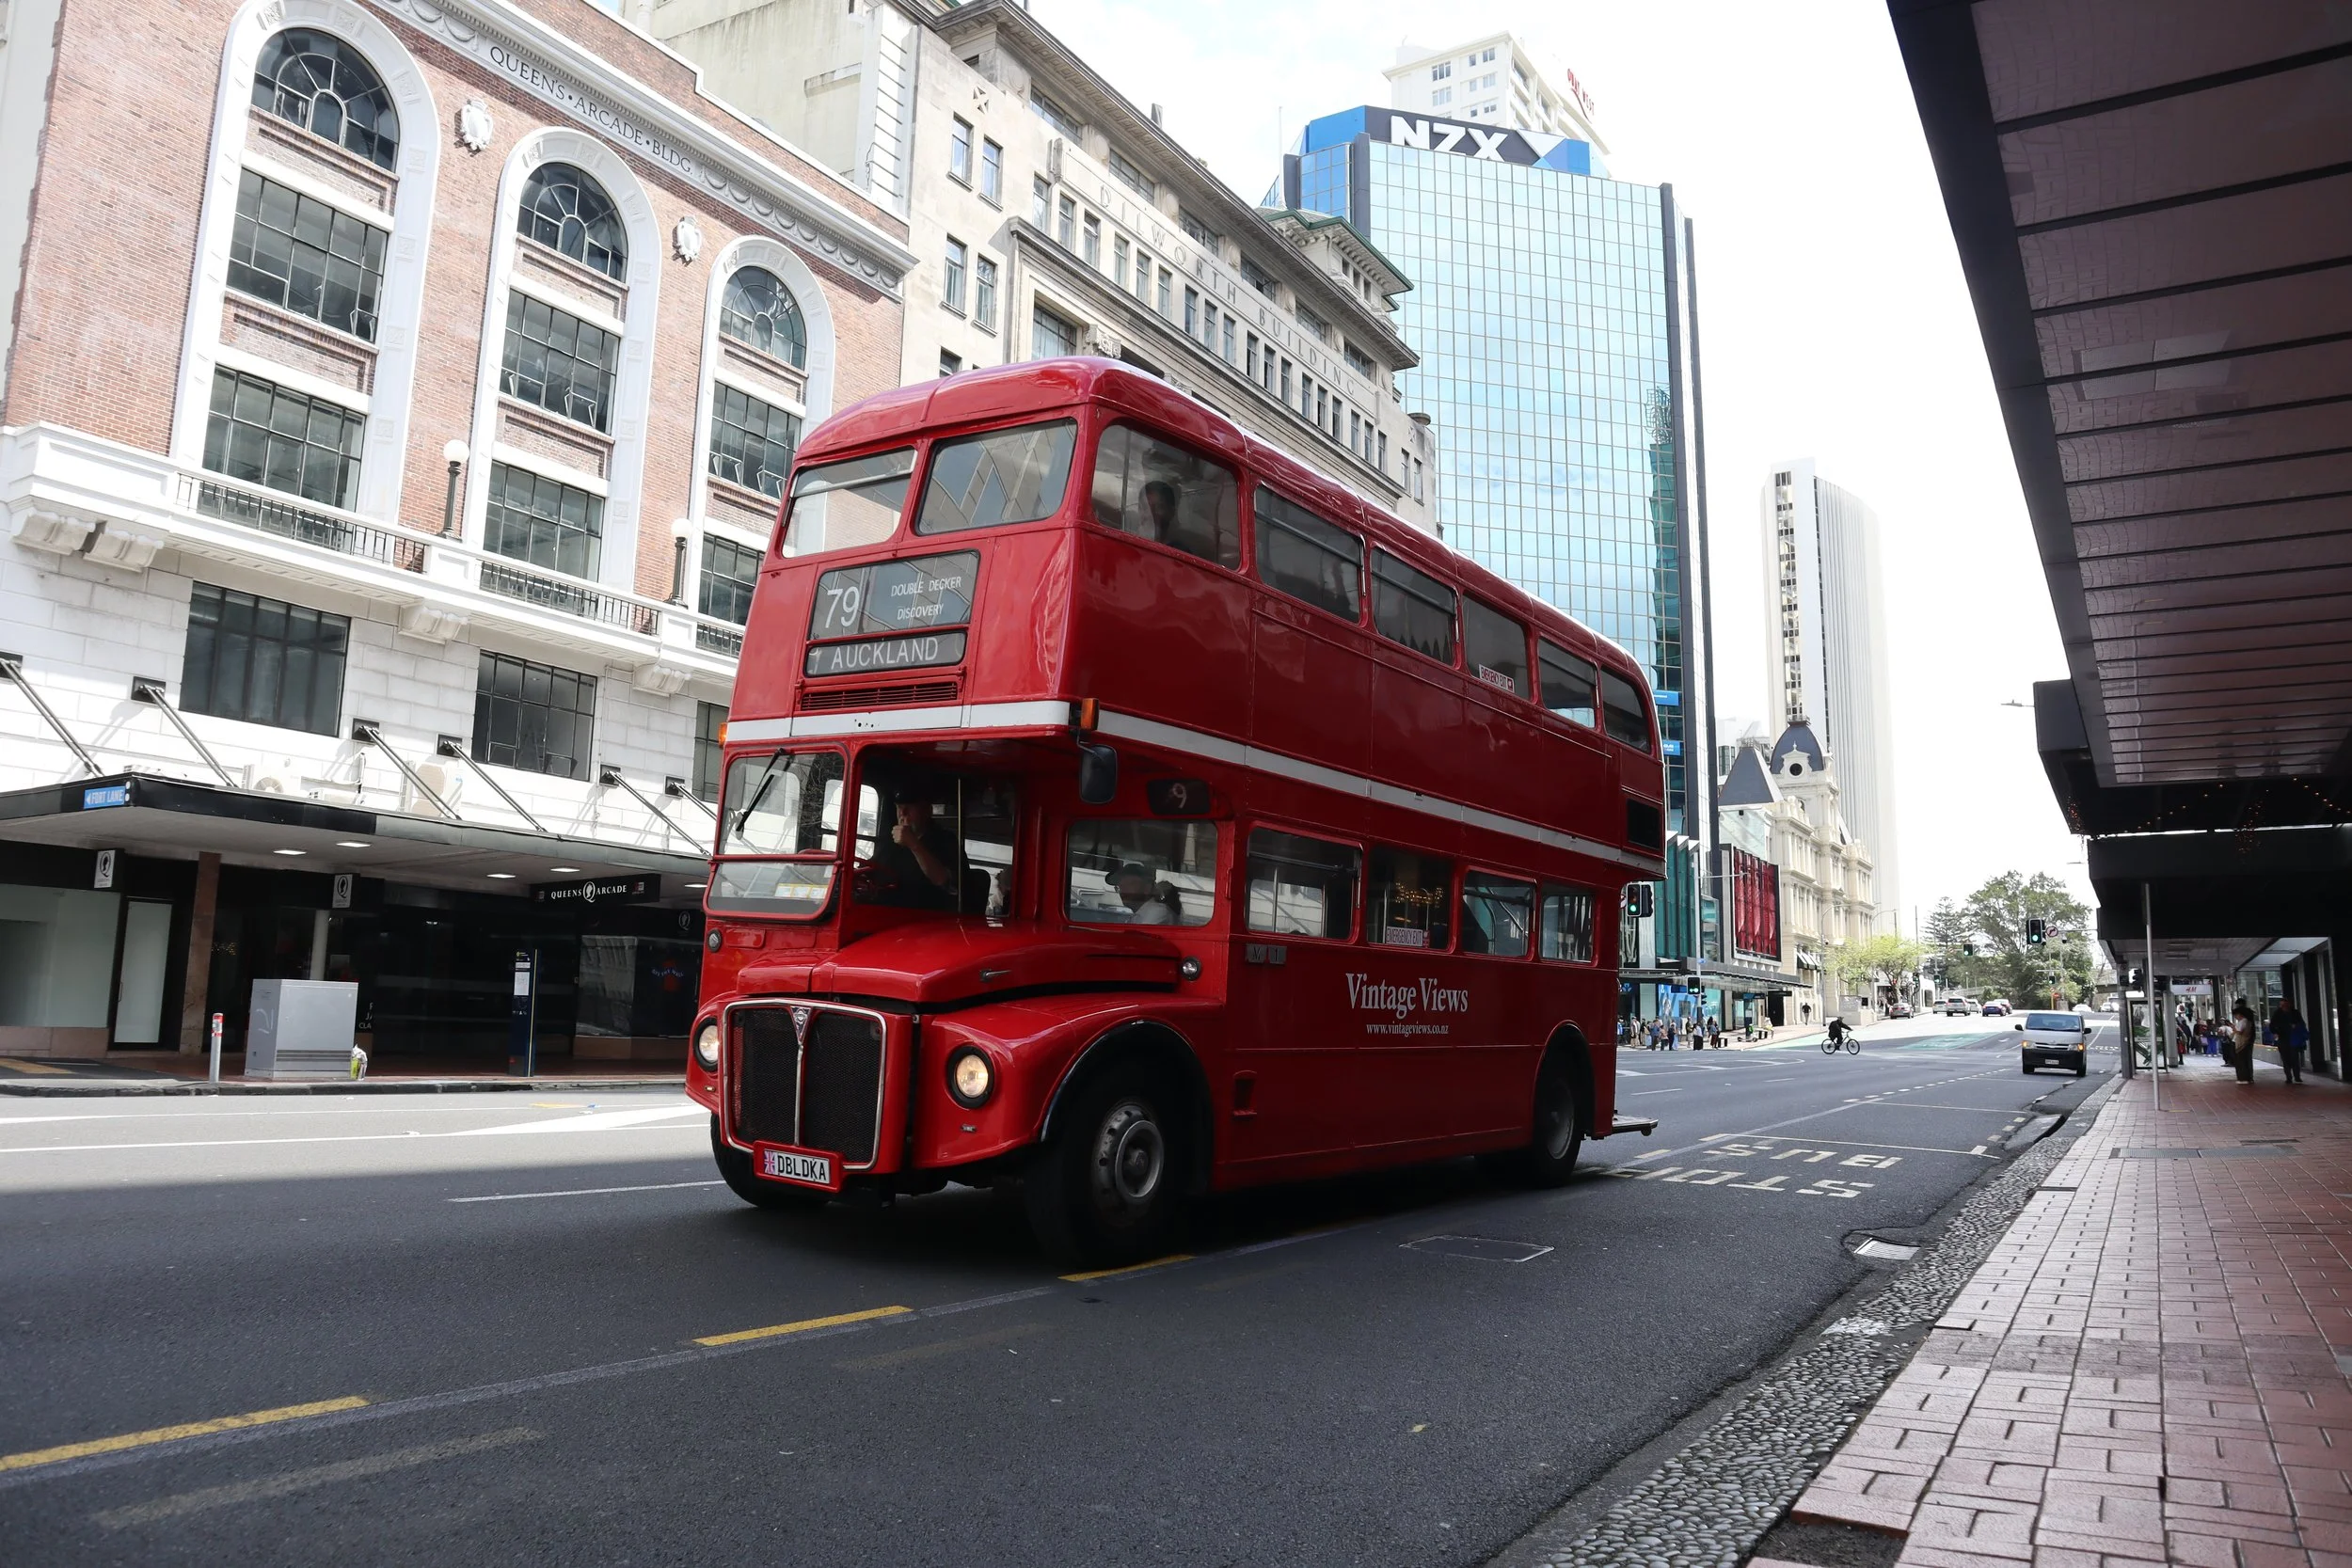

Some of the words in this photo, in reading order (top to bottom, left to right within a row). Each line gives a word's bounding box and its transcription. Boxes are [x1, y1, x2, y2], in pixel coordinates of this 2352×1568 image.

[574, 97, 644, 146] ARCADE
[1391, 115, 1508, 163] NZX
[1100, 184, 1236, 305] DILWORTH
[1259, 309, 1355, 396] BUILDING
[890, 580, 925, 597] DOUBLE
[929, 576, 961, 592] DECKER
[824, 586, 860, 629] 79
[897, 603, 945, 621] DISCOVERY
[831, 636, 939, 670] AUCKLAND
[106, 789, 124, 802] LANE
[550, 889, 582, 900] QUEENS
[596, 884, 628, 895] ARCADE
[1345, 973, 1417, 1019] Vintage
[1419, 977, 1469, 1012] Views
[1366, 1021, 1449, 1037] www.vintageviews.co.nz
[777, 1154, 827, 1180] DBLDKA
[1703, 1143, 1903, 1169] BUS
